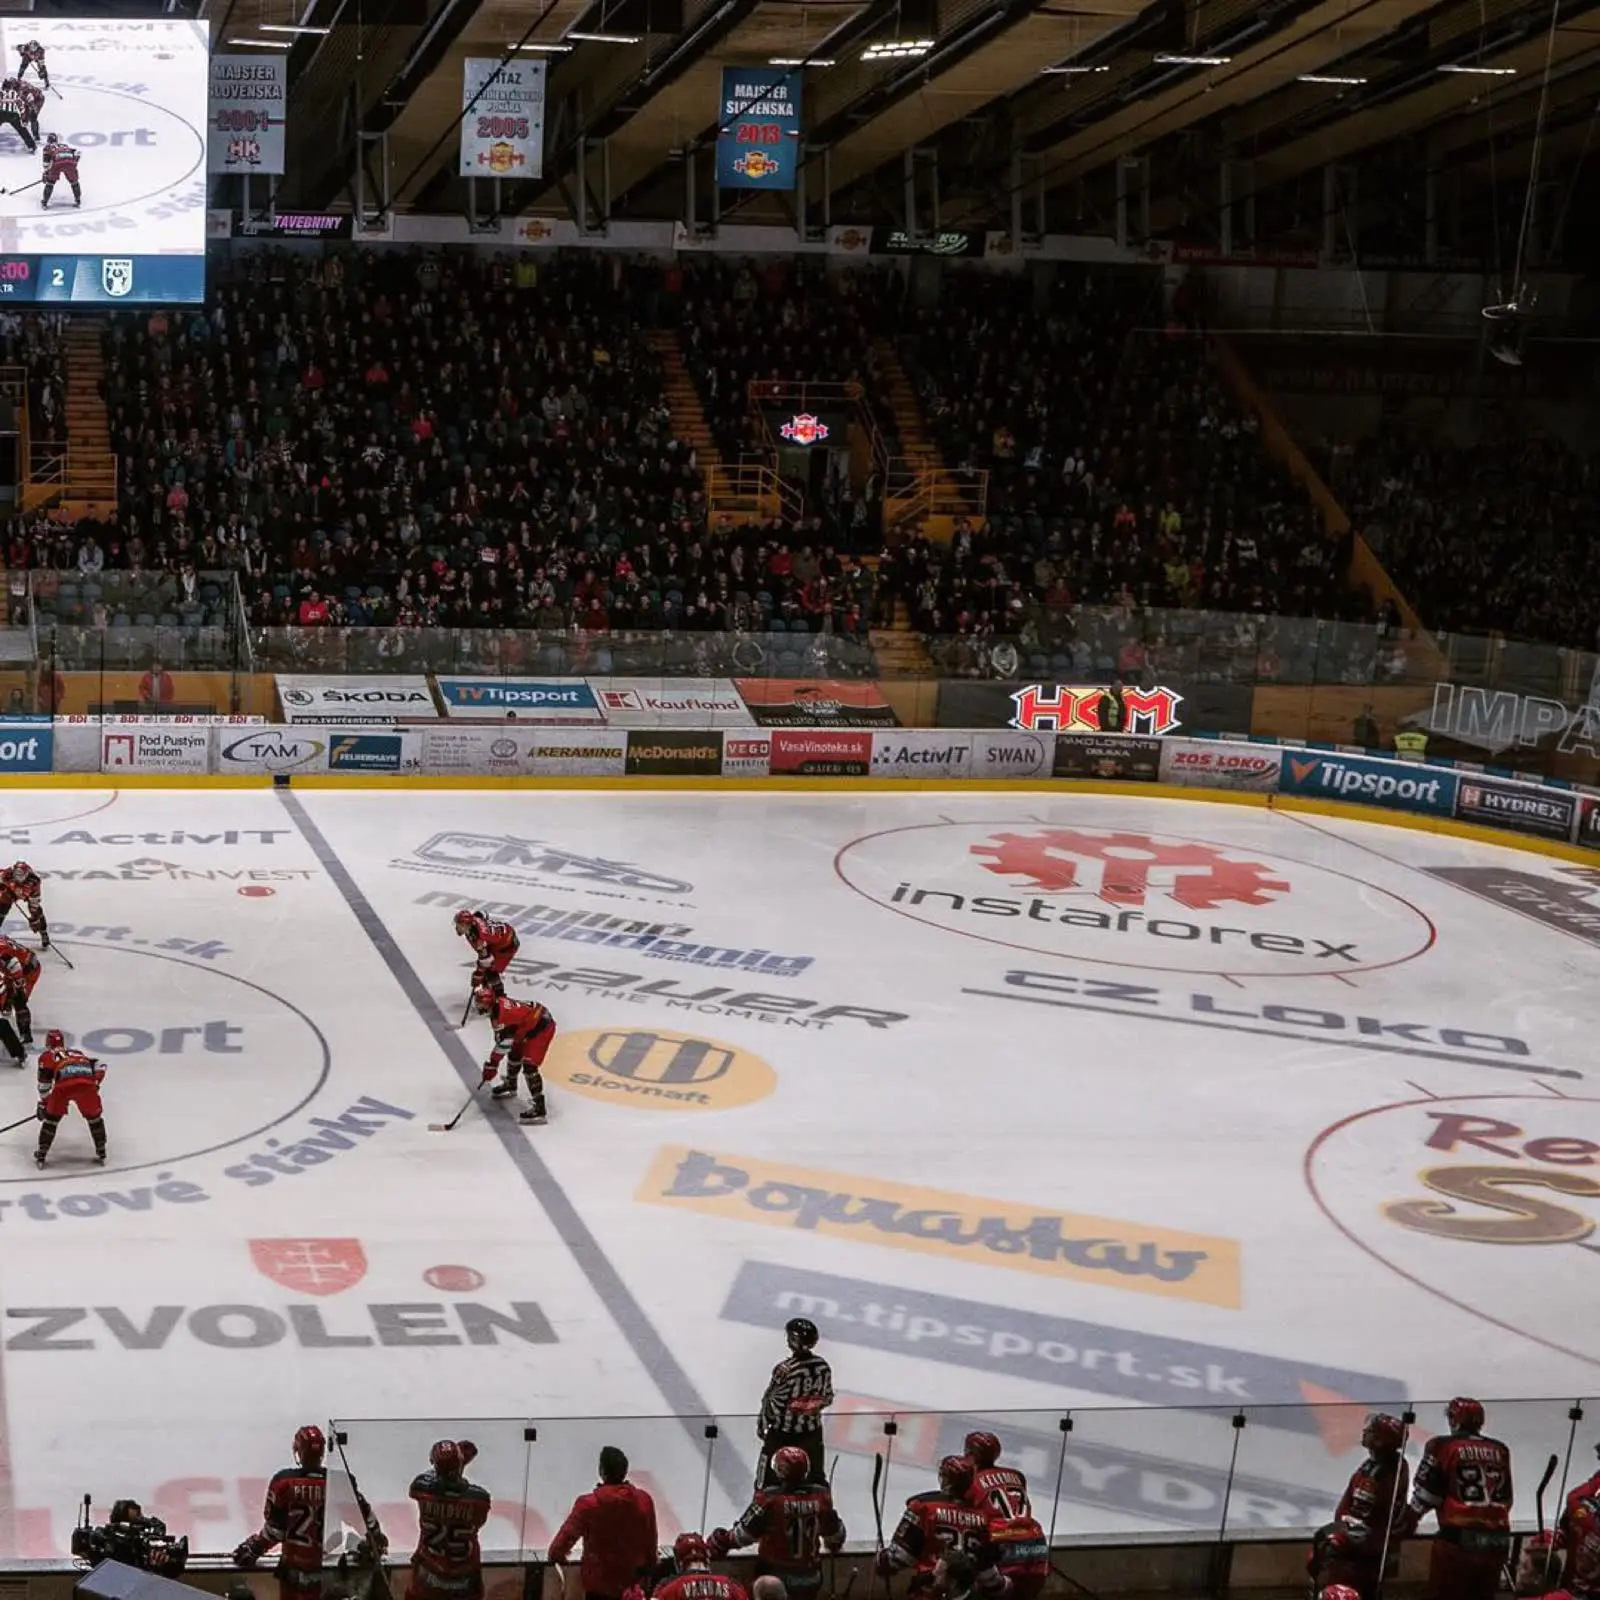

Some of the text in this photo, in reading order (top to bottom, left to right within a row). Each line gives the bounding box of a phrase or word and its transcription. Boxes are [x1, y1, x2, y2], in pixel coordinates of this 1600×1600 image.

[734, 84, 788, 99] MAJSTER
[726, 100, 795, 116] SLOVENSKA
[477, 116, 529, 139] 2005
[736, 122, 782, 144] 2013
[52, 269, 65, 286] 2
[323, 689, 428, 702] ŠKODA
[646, 698, 740, 710] Kaufland
[68, 715, 87, 724] BDI
[120, 715, 139, 724] BDI
[174, 715, 193, 724] BDI
[229, 715, 247, 724] BDI
[140, 735, 205, 748] Pod Pustým
[728, 743, 768, 754] VEGO
[139, 745, 182, 756] hradom
[250, 744, 297, 757] TAM
[538, 747, 623, 758] KERAMING
[629, 746, 718, 760] McDonald's
[895, 746, 969, 763] ActivIT
[985, 746, 1035, 763] SWAN
[1216, 755, 1267, 770] LOKO
[1321, 762, 1441, 804] Tipsport
[1484, 793, 1564, 819] HYDREX
[49, 830, 292, 845] ActivIT
[170, 870, 321, 881] INVEST
[890, 881, 1361, 964] instaforex
[583, 986, 650, 1005] THE
[665, 998, 836, 1031] MOMENT
[1004, 969, 1530, 1057] CZ LOKO
[568, 1071, 710, 1105] Slovnaft
[224, 1095, 416, 1187] stávky
[5, 1301, 560, 1351] ZVOLEN
